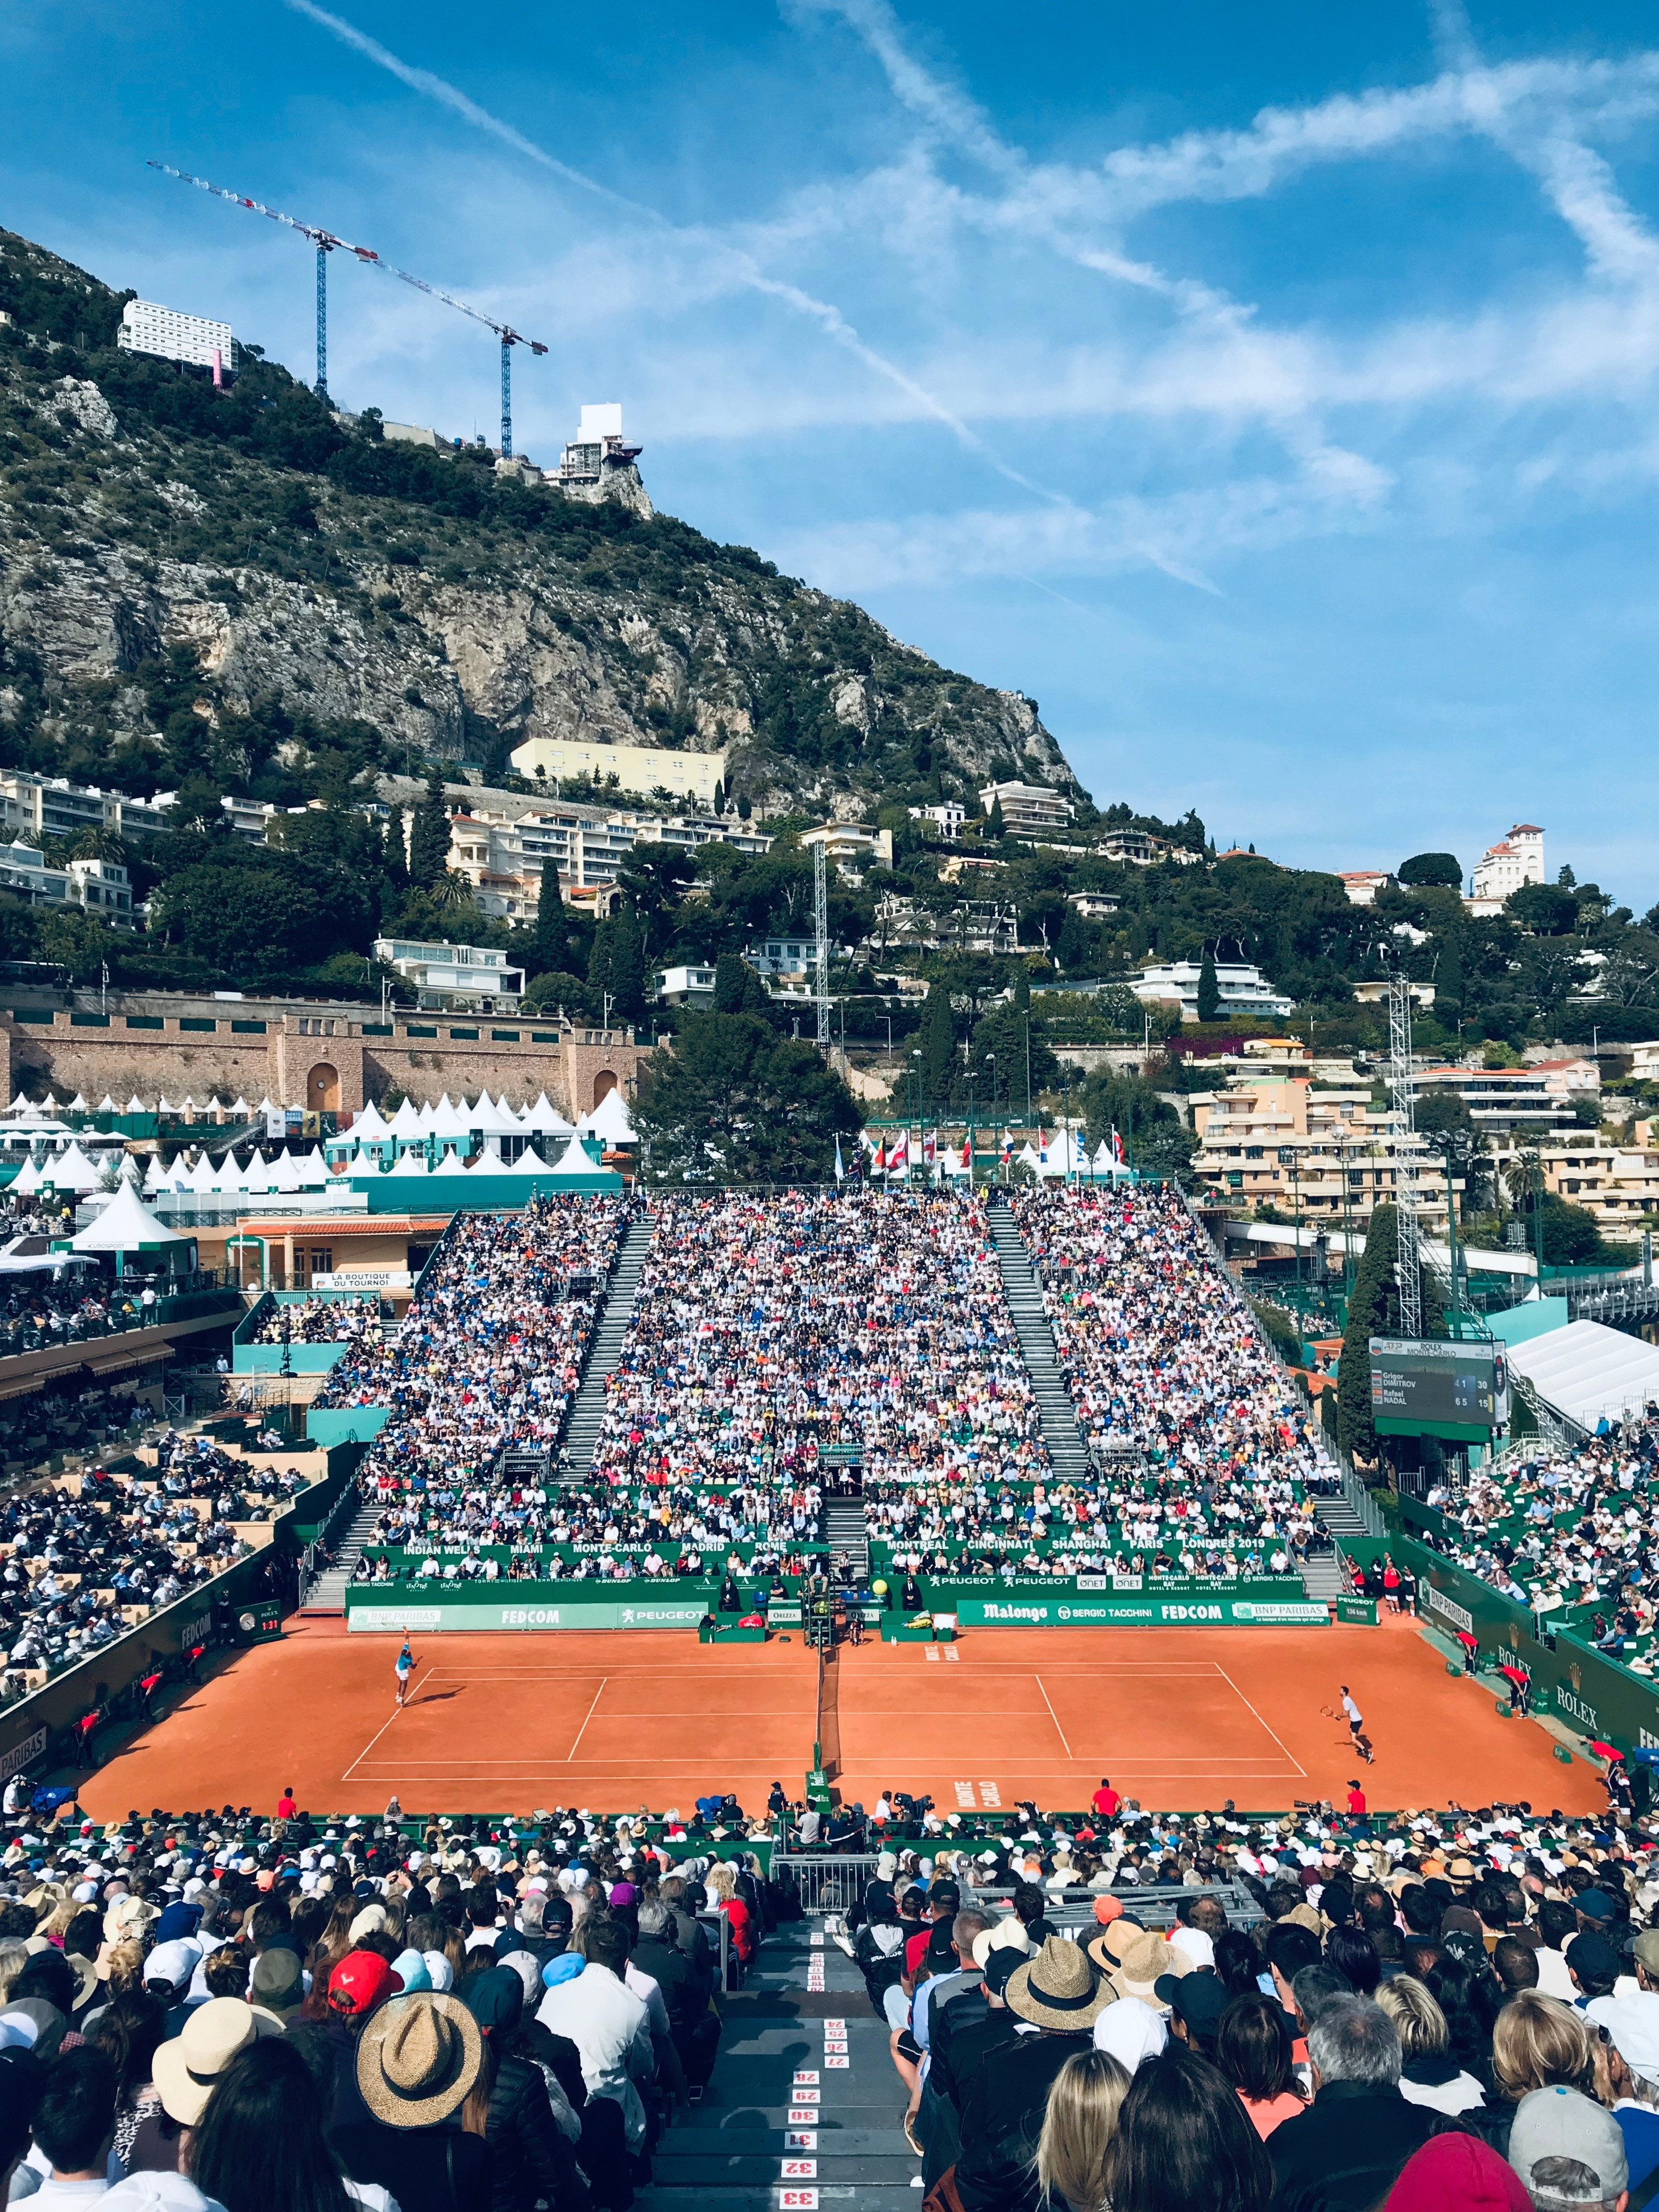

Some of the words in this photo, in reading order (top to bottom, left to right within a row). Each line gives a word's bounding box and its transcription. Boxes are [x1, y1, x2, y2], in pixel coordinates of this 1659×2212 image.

[1407, 1348, 1457, 1358] MONTE-CARLO
[1383, 1372, 1404, 1381] Grigor
[1384, 1397, 1407, 1405] NADAL
[573, 1543, 652, 1553] MONTE-CARLO
[682, 1542, 725, 1552] MADRID
[755, 1542, 786, 1551] ROME
[887, 1541, 949, 1550] MONTREAL
[967, 1540, 1034, 1549] CINCINNATI
[1052, 1539, 1111, 1549] SHANGHAI
[1130, 1539, 1164, 1549] PARIS
[1183, 1539, 1235, 1549] LONDRES
[1238, 1539, 1266, 1548] 2019
[404, 1546, 441, 1555] INDIAN
[445, 1545, 480, 1554] WELLS
[511, 1545, 543, 1554] MIAMI
[1338, 1596, 1374, 1605] PEUGEOT
[983, 1604, 1048, 1622] Malongo
[1108, 1609, 1152, 1617] TACCHINI
[1161, 1605, 1222, 1619] FEDCOM
[1255, 1606, 1276, 1615] BNP
[1279, 1606, 1322, 1615] PARIBAS
[1431, 1589, 1444, 1609] BNP
[1444, 1597, 1470, 1629] PARIBAS
[371, 1612, 391, 1621] BNP
[394, 1612, 436, 1620] PARIBAS
[501, 1611, 559, 1624] FEDCOM
[637, 1611, 705, 1620] PEUGEOT
[262, 1620, 278, 1630] 1:31
[182, 1612, 211, 1650] FEDCOM
[1557, 1685, 1598, 1730] ROLEX
[1, 1732, 43, 1778] PARIBAS
[954, 1782, 976, 1807] MONTE
[978, 1781, 1002, 1807] CARLO
[791, 2111, 814, 2120] 30
[790, 2134, 810, 2146] 31
[786, 2163, 811, 2173] 32
[784, 2193, 812, 2205] 33
